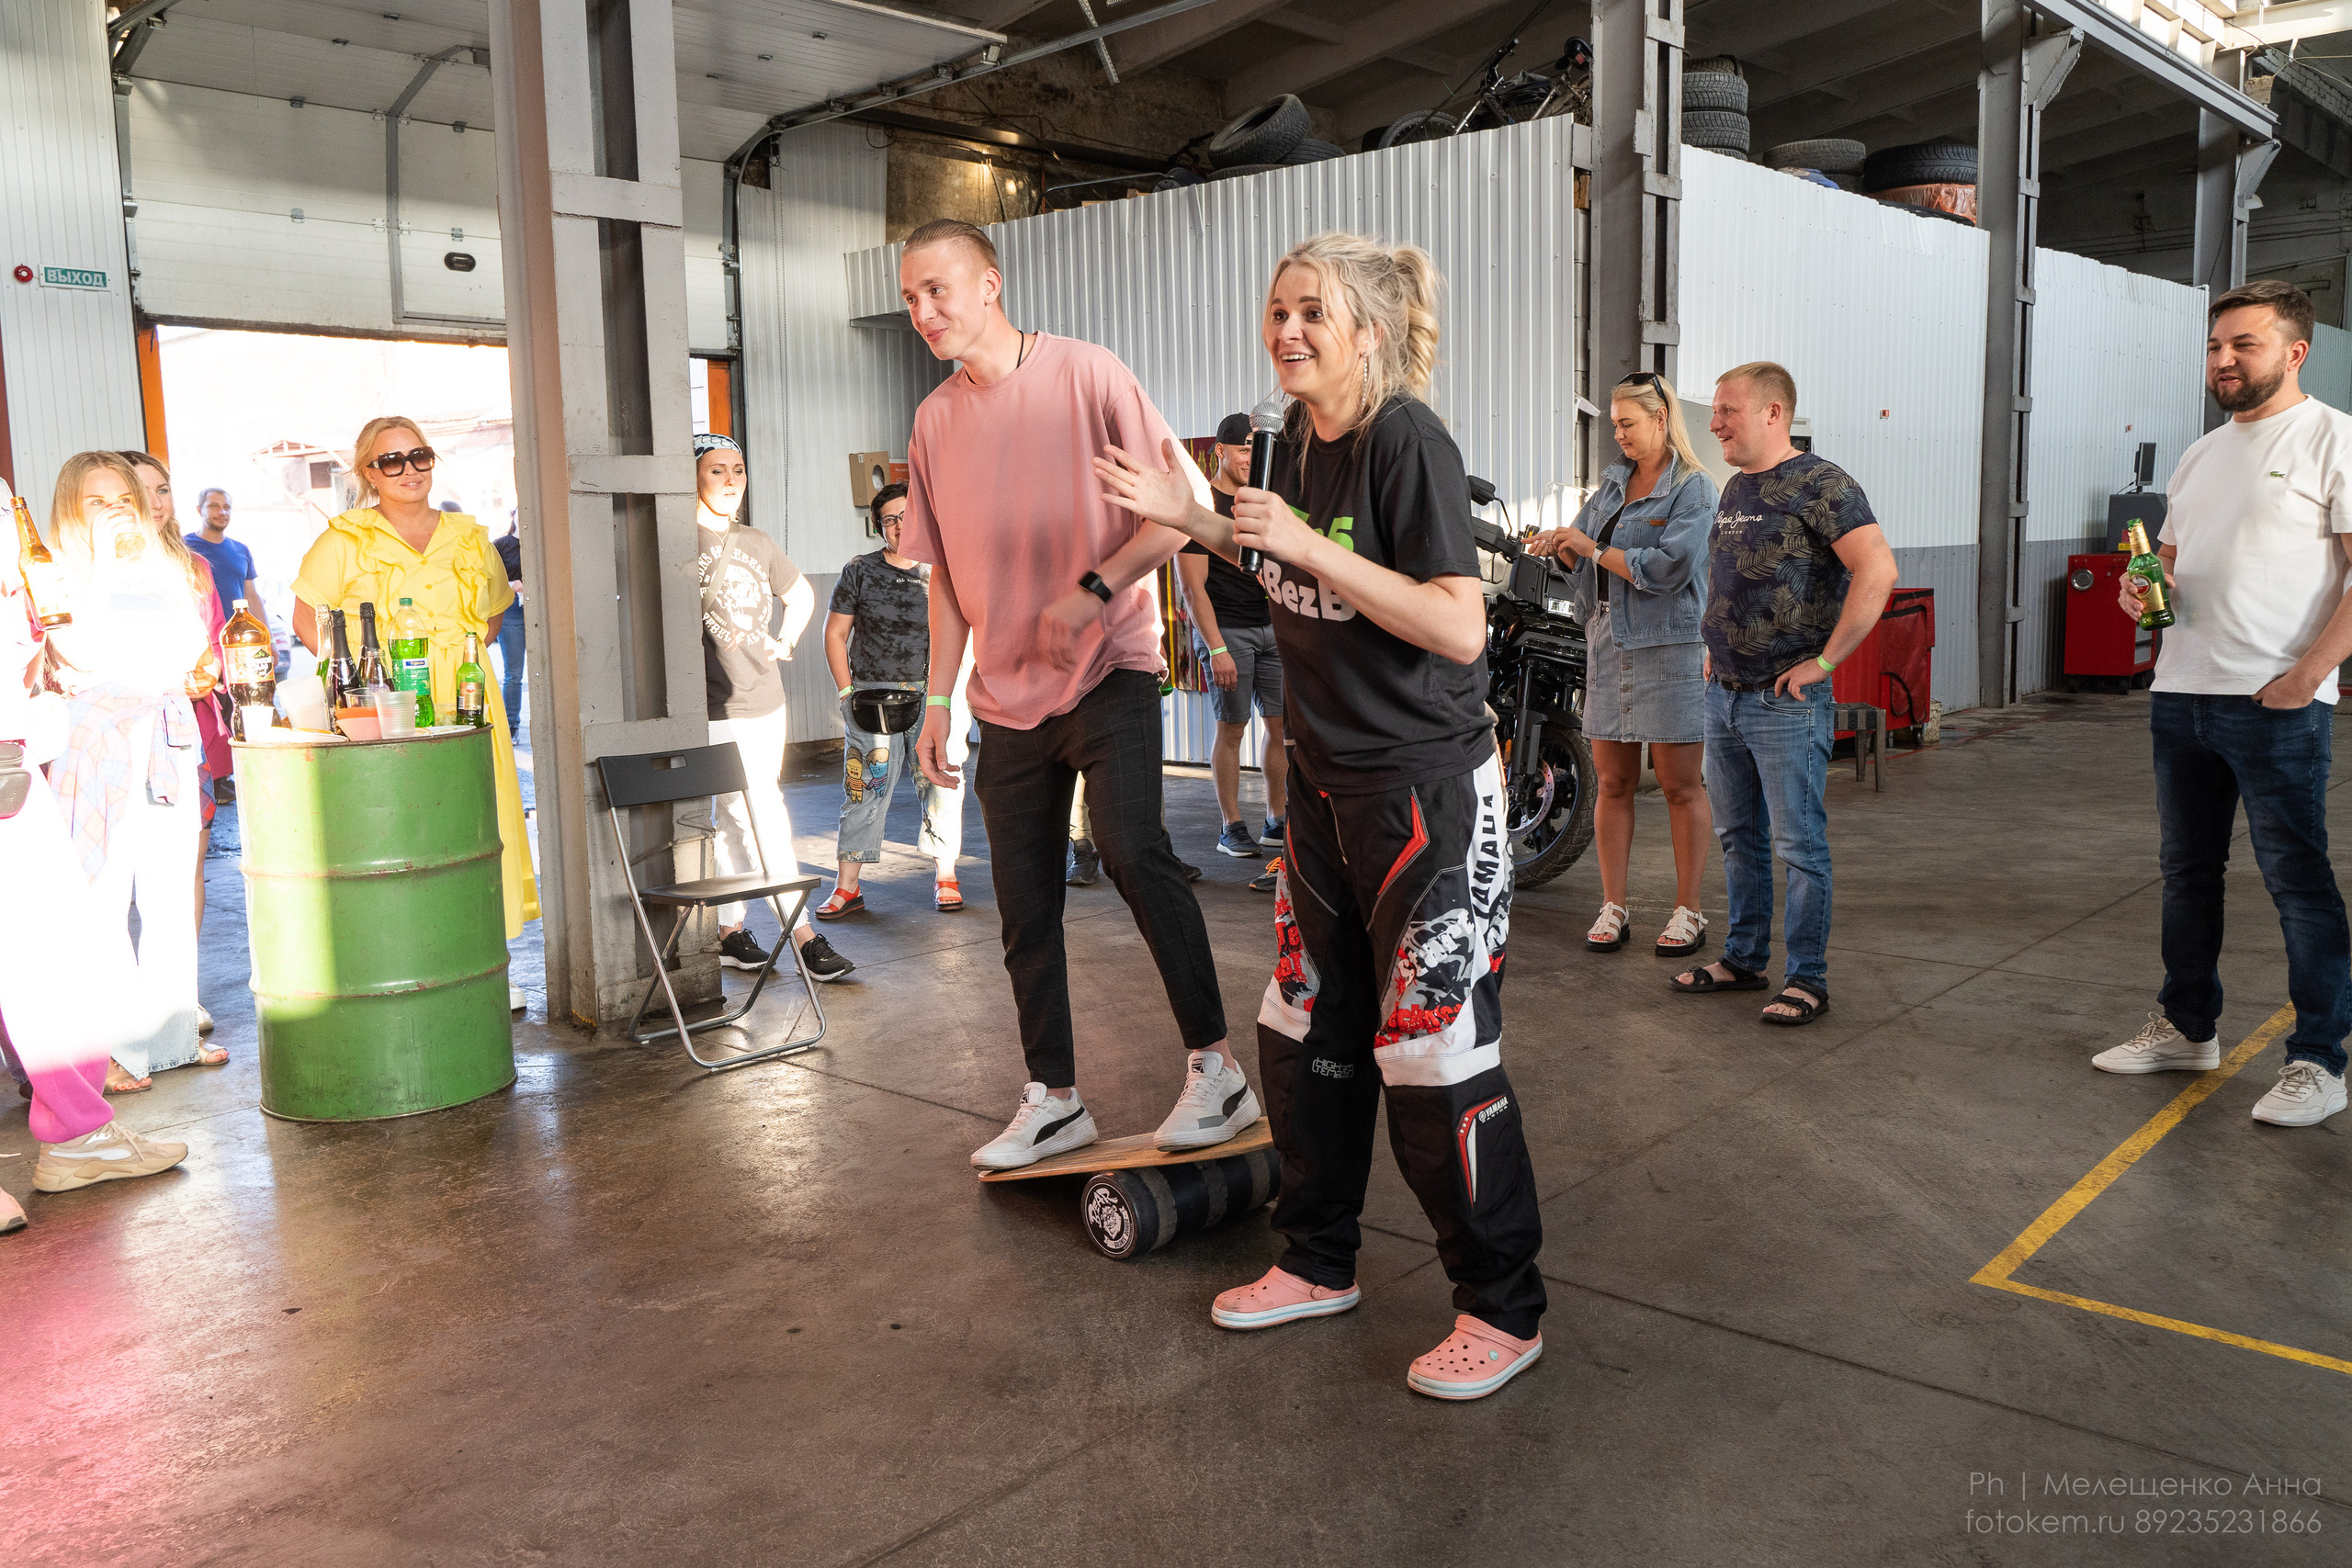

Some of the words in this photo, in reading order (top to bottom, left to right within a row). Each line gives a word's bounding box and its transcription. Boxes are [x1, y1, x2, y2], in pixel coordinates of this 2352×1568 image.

[46, 269, 105, 287] ВЫХОД
[1730, 510, 1763, 529] Jeans
[1316, 1056, 1341, 1070] HIGH
[1485, 1096, 1509, 1117] YAMAHA
